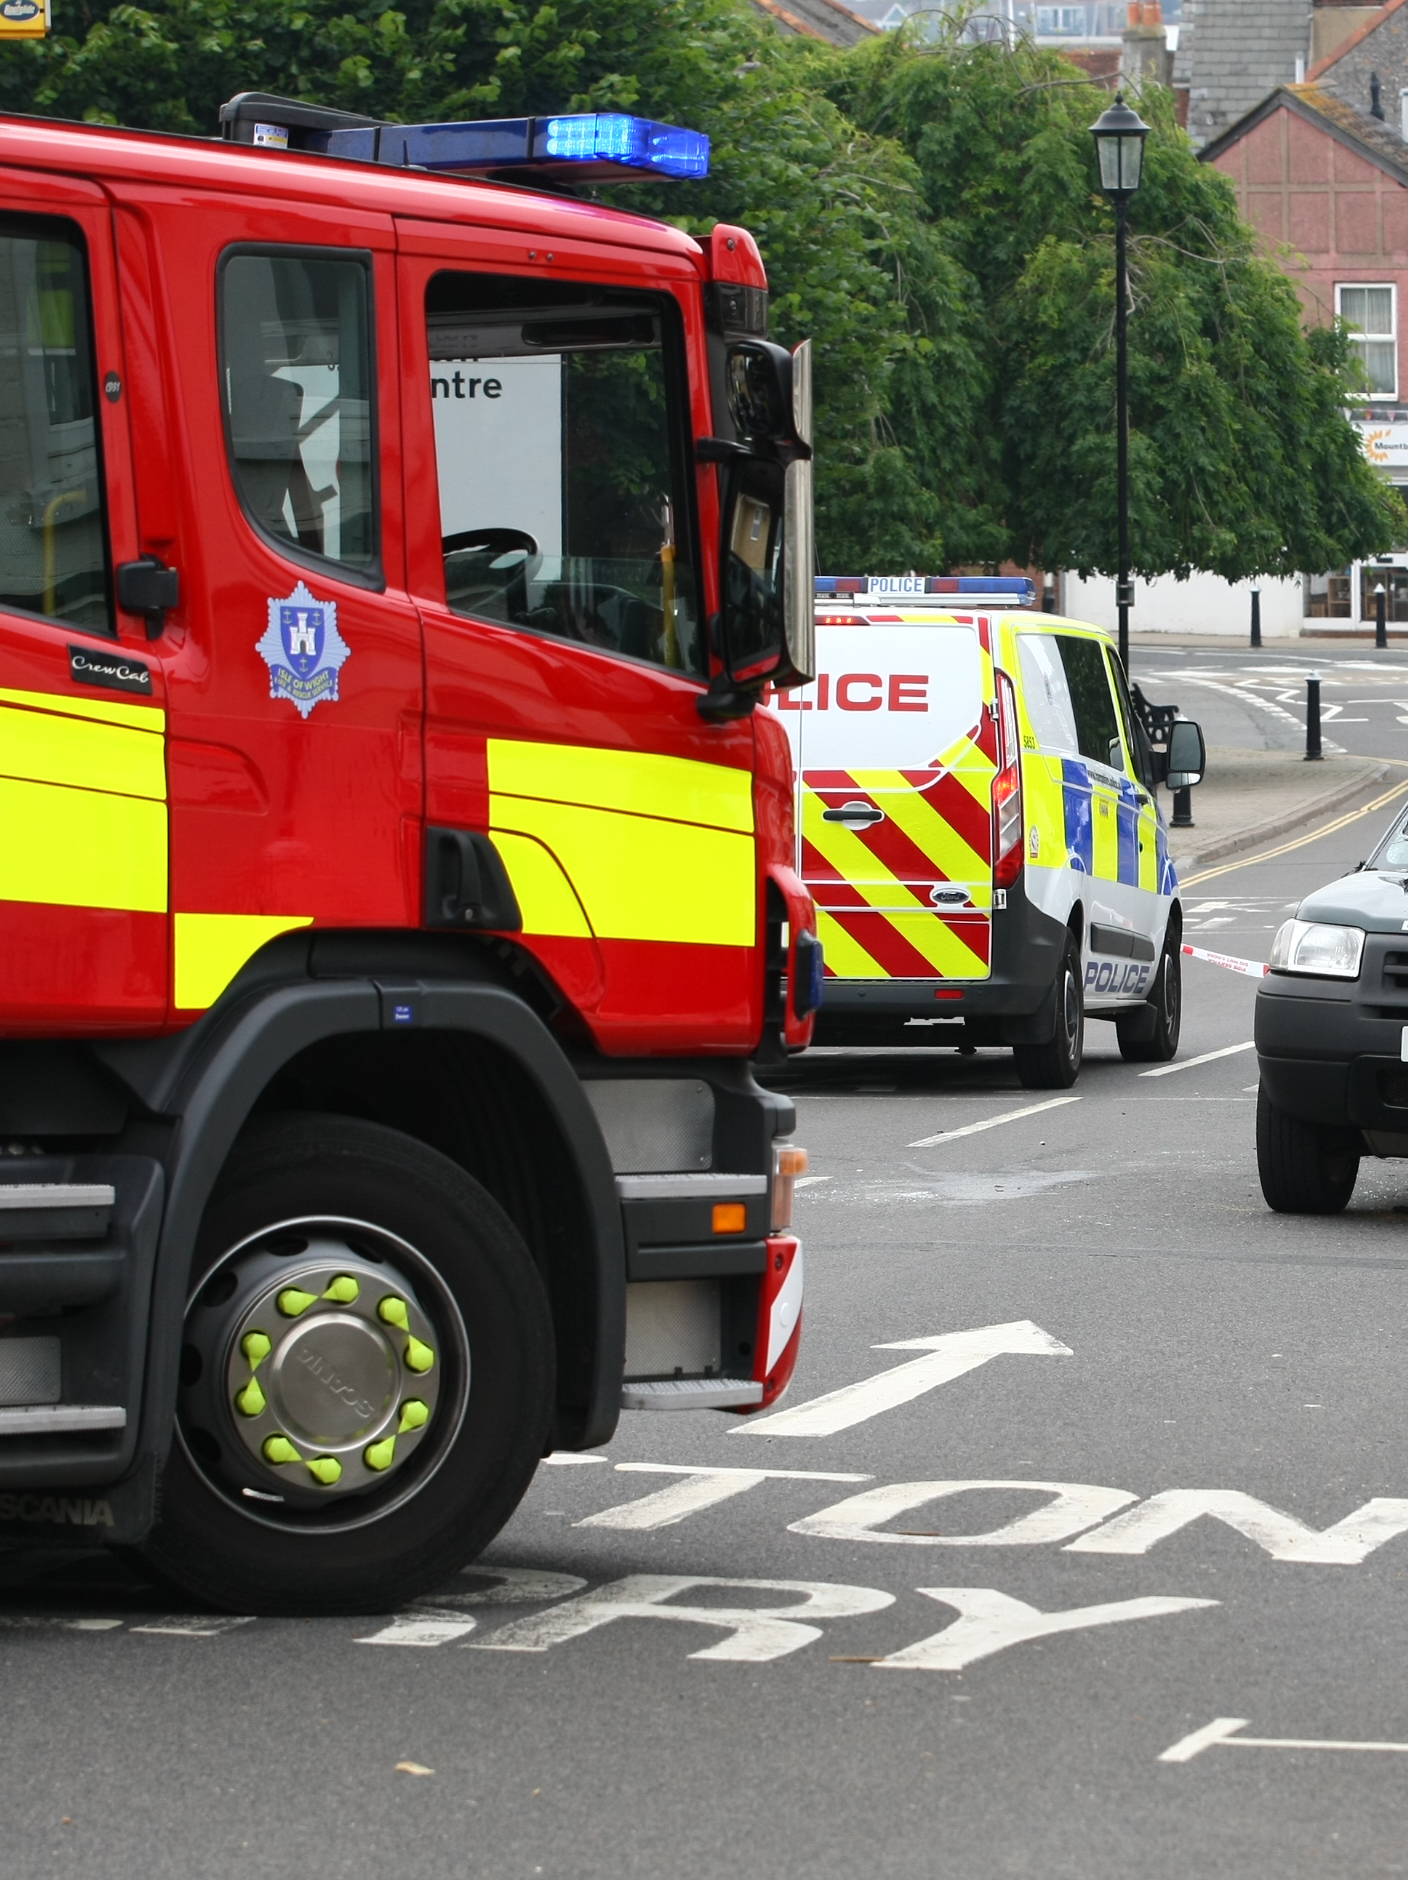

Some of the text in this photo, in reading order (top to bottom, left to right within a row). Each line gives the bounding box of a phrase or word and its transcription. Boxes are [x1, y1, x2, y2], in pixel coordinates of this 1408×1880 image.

[431, 370, 502, 399] ntre
[870, 577, 922, 592] POLICE
[278, 667, 329, 690] ISLE OF WIGHT
[762, 673, 929, 712] LICE
[940, 891, 960, 900] Ford
[1083, 961, 1151, 994] POLICE
[0, 1492, 115, 1527] SCANIA
